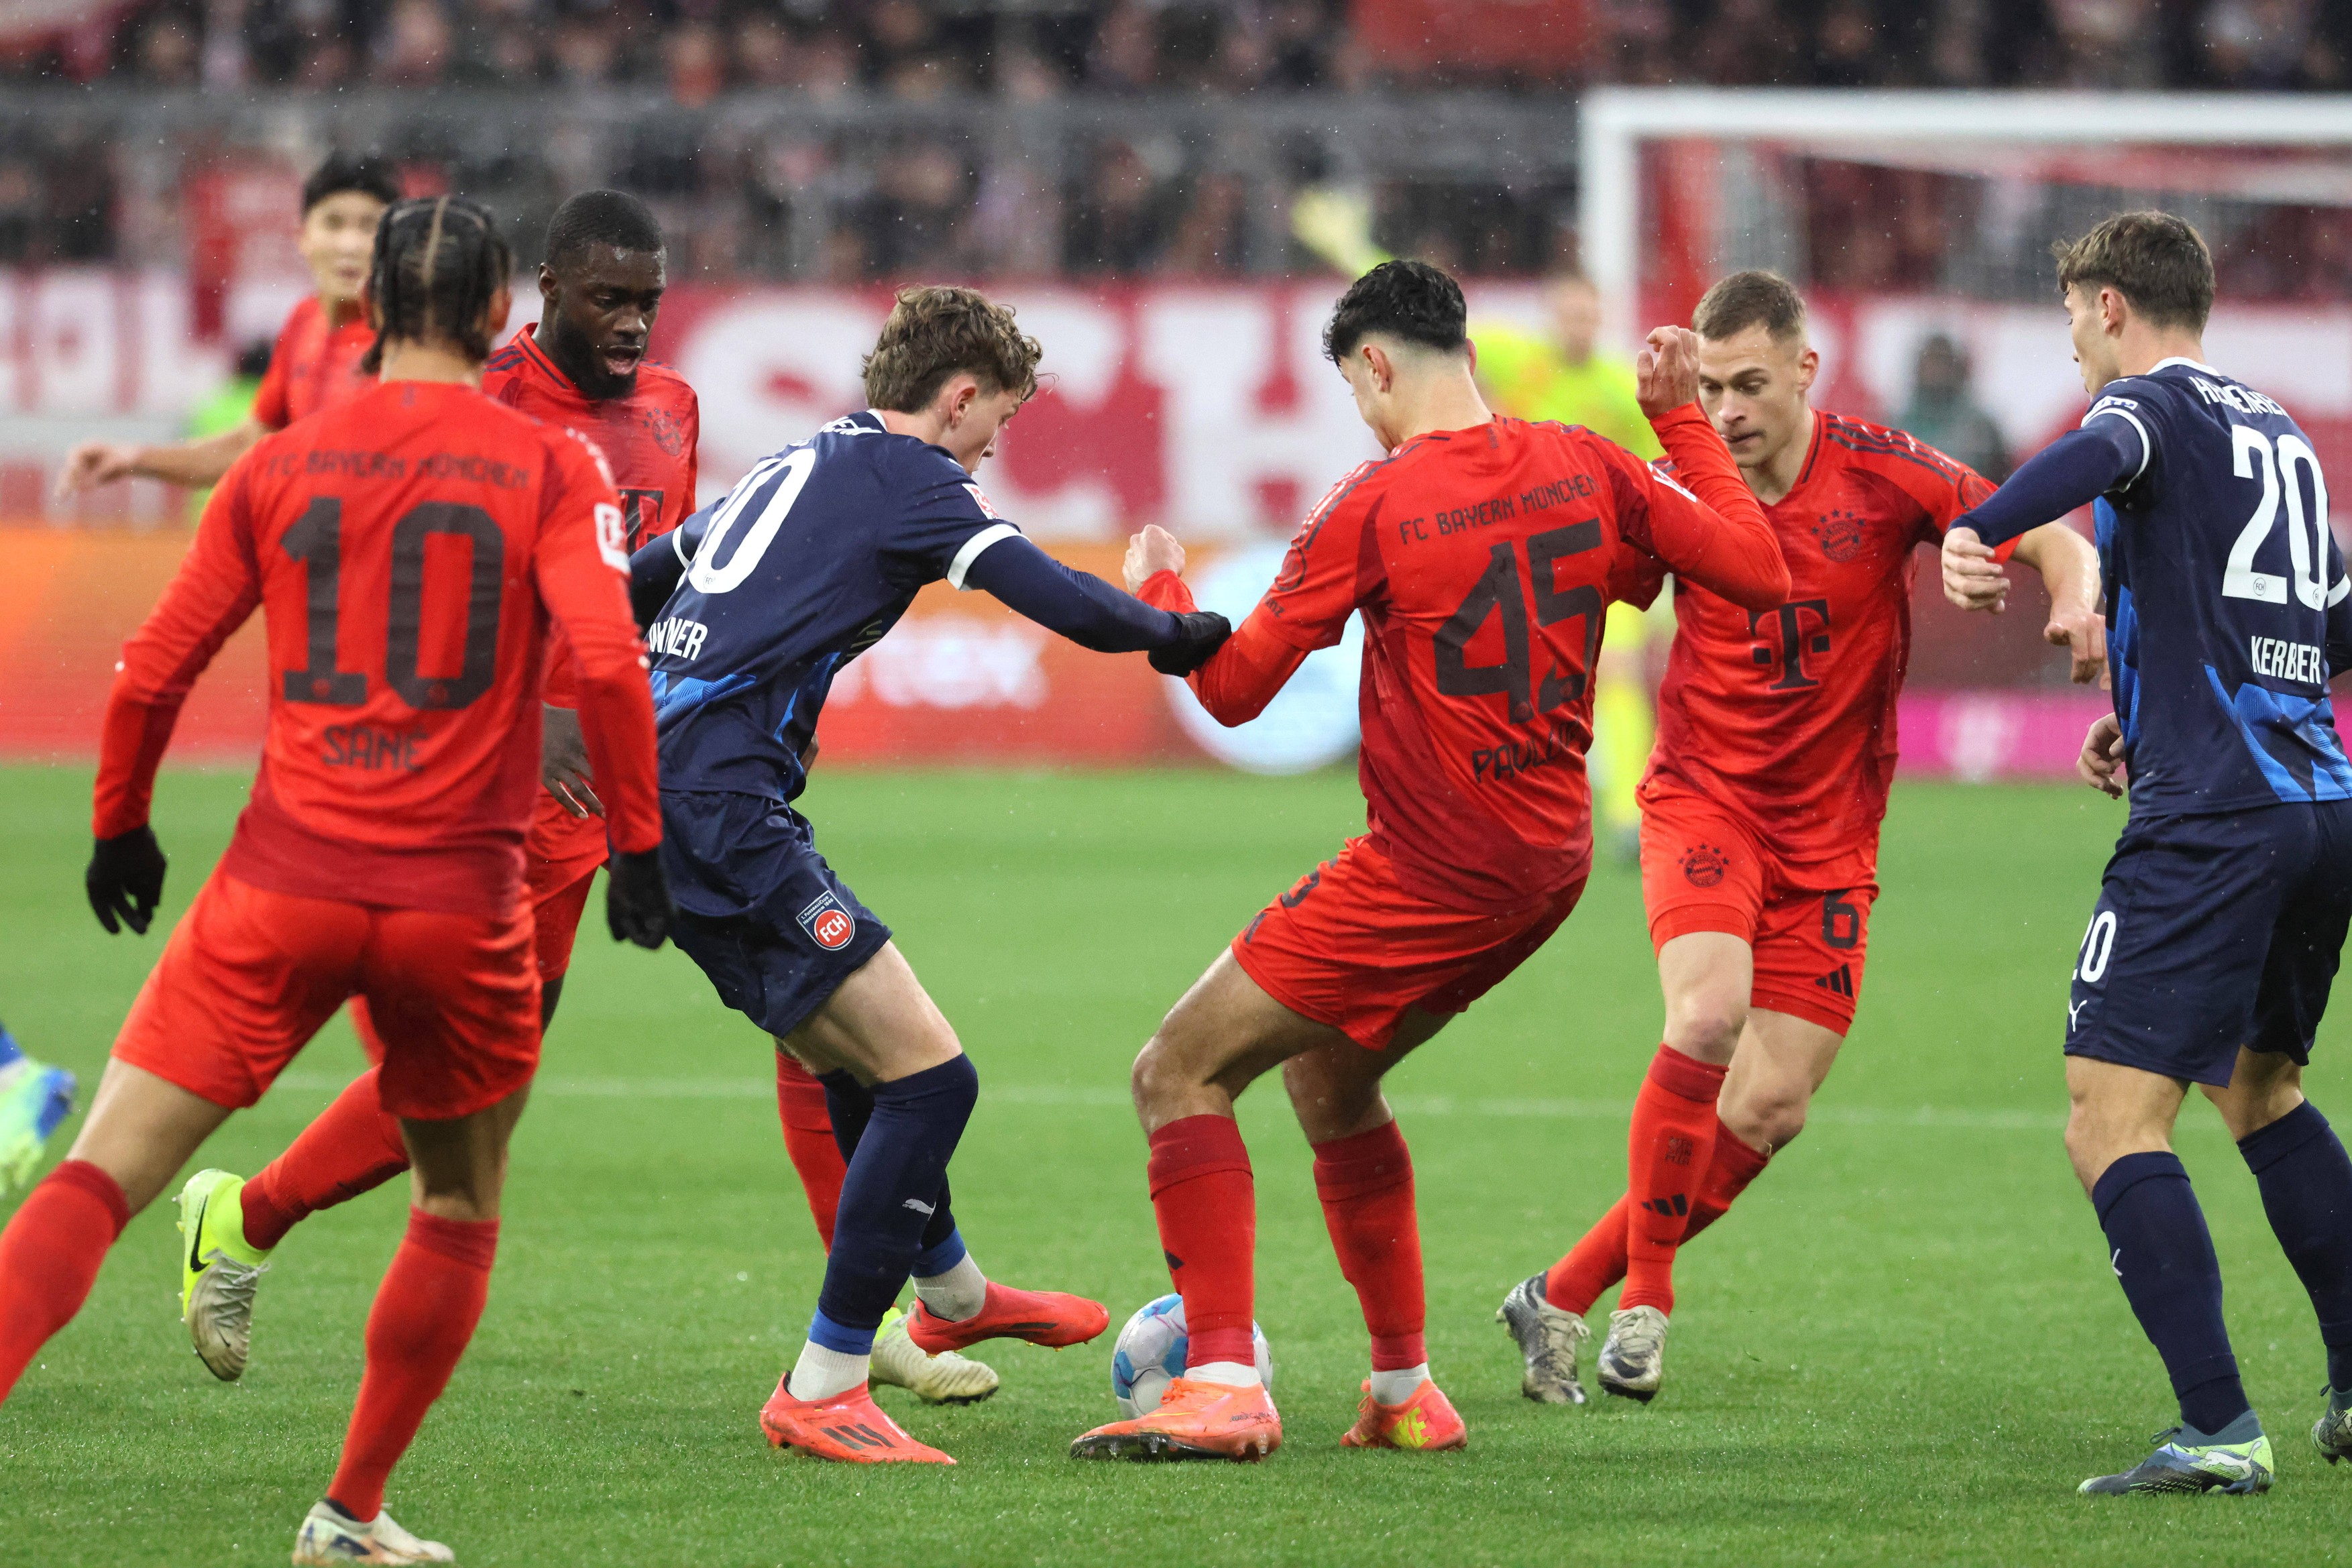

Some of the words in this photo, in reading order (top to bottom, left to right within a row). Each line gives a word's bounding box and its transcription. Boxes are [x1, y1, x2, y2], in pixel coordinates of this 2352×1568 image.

[307, 450, 405, 479] BAYERN
[1399, 518, 1429, 545] FC
[1435, 495, 1515, 536] BAYERN
[1519, 473, 1602, 514] MÜNCHEN
[2222, 424, 2329, 612] 20
[280, 496, 506, 711] 10
[1433, 516, 1602, 724] 45
[2251, 635, 2321, 685] KERBER
[819, 914, 847, 942] FCH
[1822, 889, 1860, 950] 6
